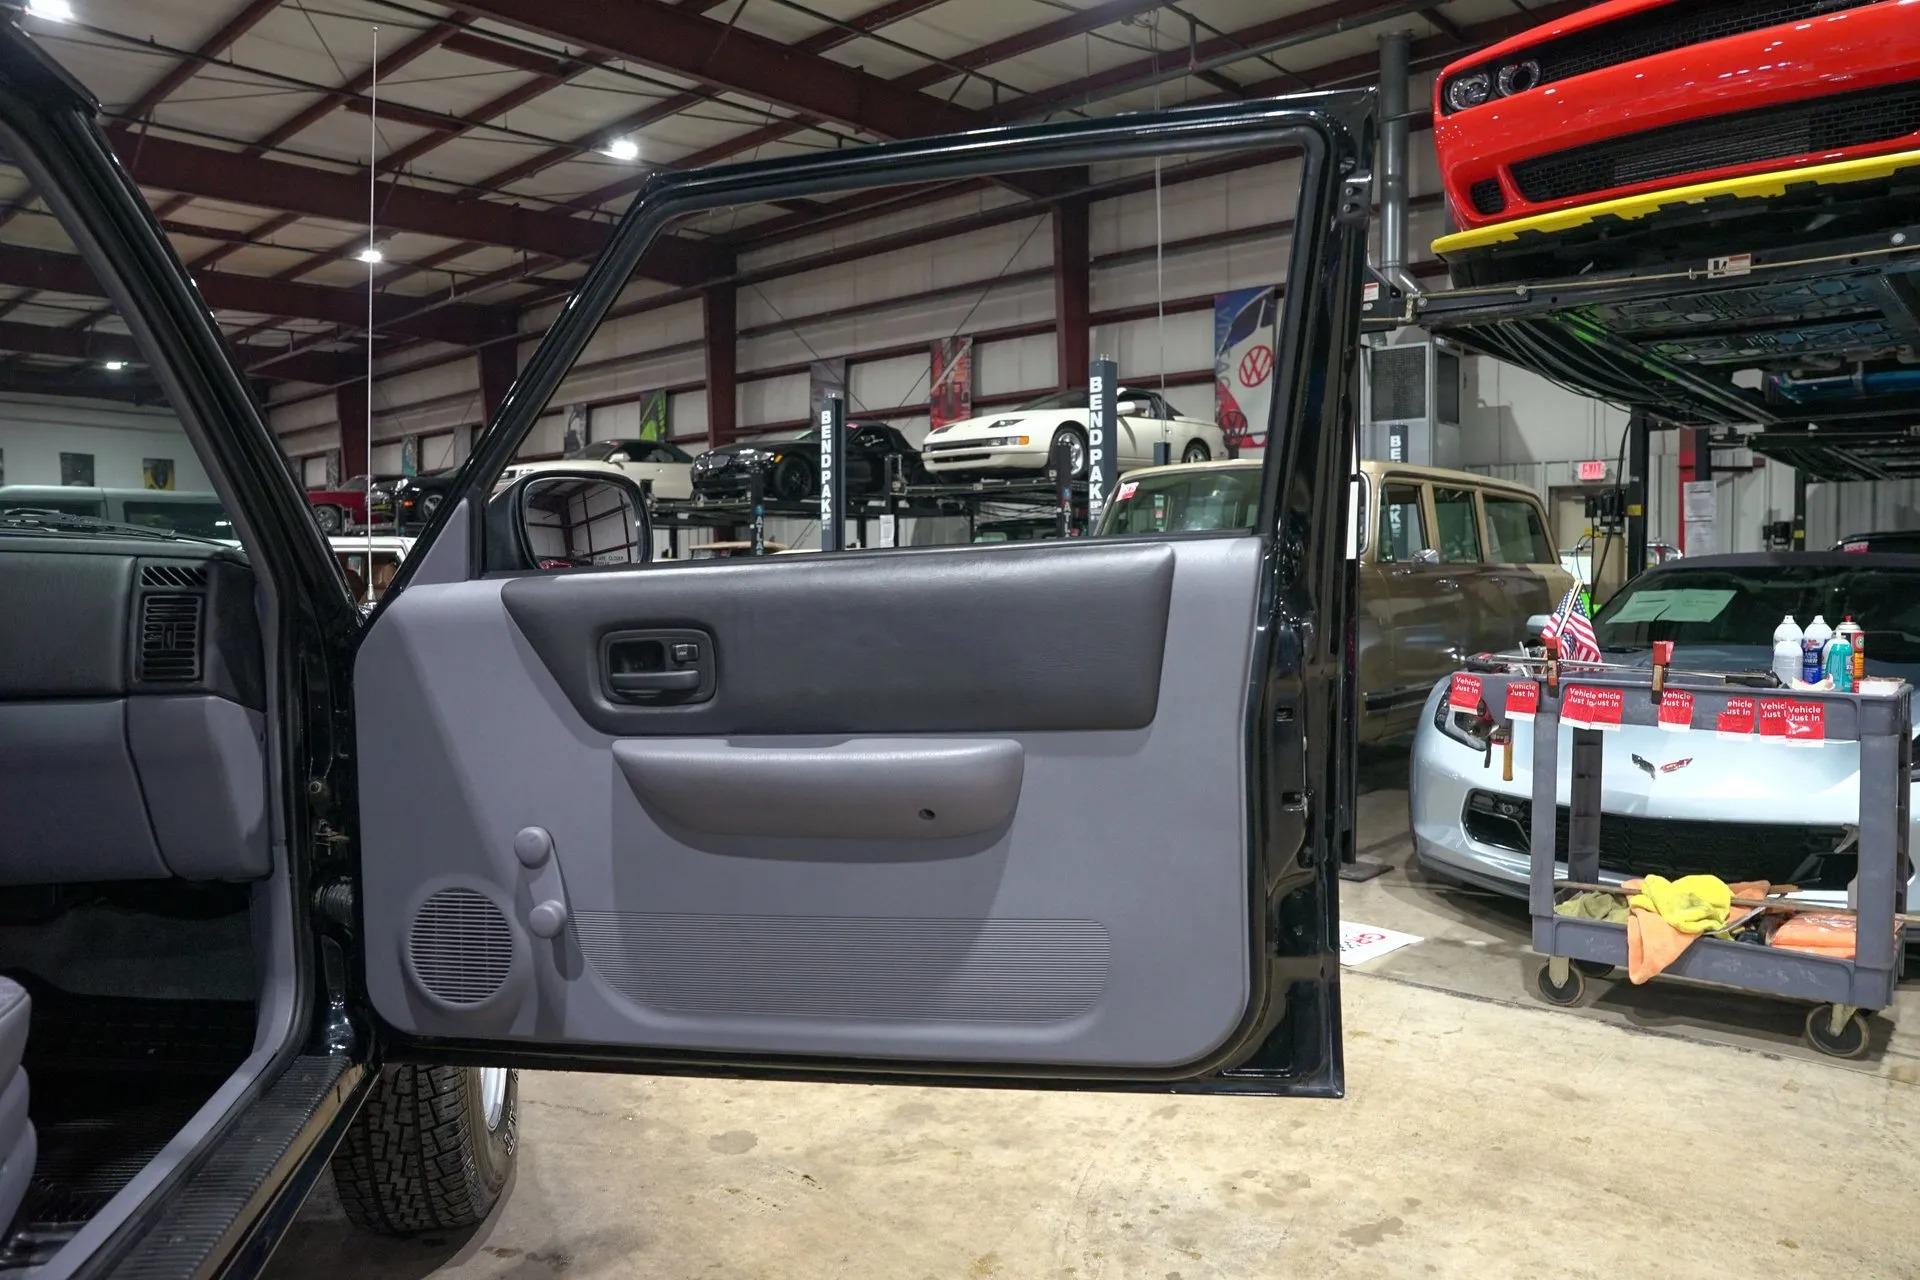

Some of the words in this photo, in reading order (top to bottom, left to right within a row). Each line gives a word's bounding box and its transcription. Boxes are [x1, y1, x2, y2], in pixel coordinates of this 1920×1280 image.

[1089, 376, 1103, 500] BENDPAK
[821, 410, 832, 513] BENDPAK
[1456, 677, 1481, 687] Vehicle
[1455, 685, 1469, 693] Just
[1510, 689, 1526, 697] Just
[1527, 690, 1535, 698] In
[1569, 688, 1597, 699] Vehicle
[1597, 692, 1621, 700] ehicle
[1662, 691, 1691, 700] Vehicle
[1568, 696, 1585, 705] Just
[1597, 699, 1610, 707] ust
[1611, 700, 1619, 708] In
[1662, 699, 1680, 707] Just
[1681, 700, 1690, 708] In
[1727, 699, 1753, 708] ehicle
[1726, 708, 1740, 716] ust
[1742, 708, 1751, 716] In
[1762, 710, 1777, 718] Just
[1787, 705, 1821, 714] Vehicle
[1789, 713, 1809, 722] Just
[1811, 714, 1820, 722] In
